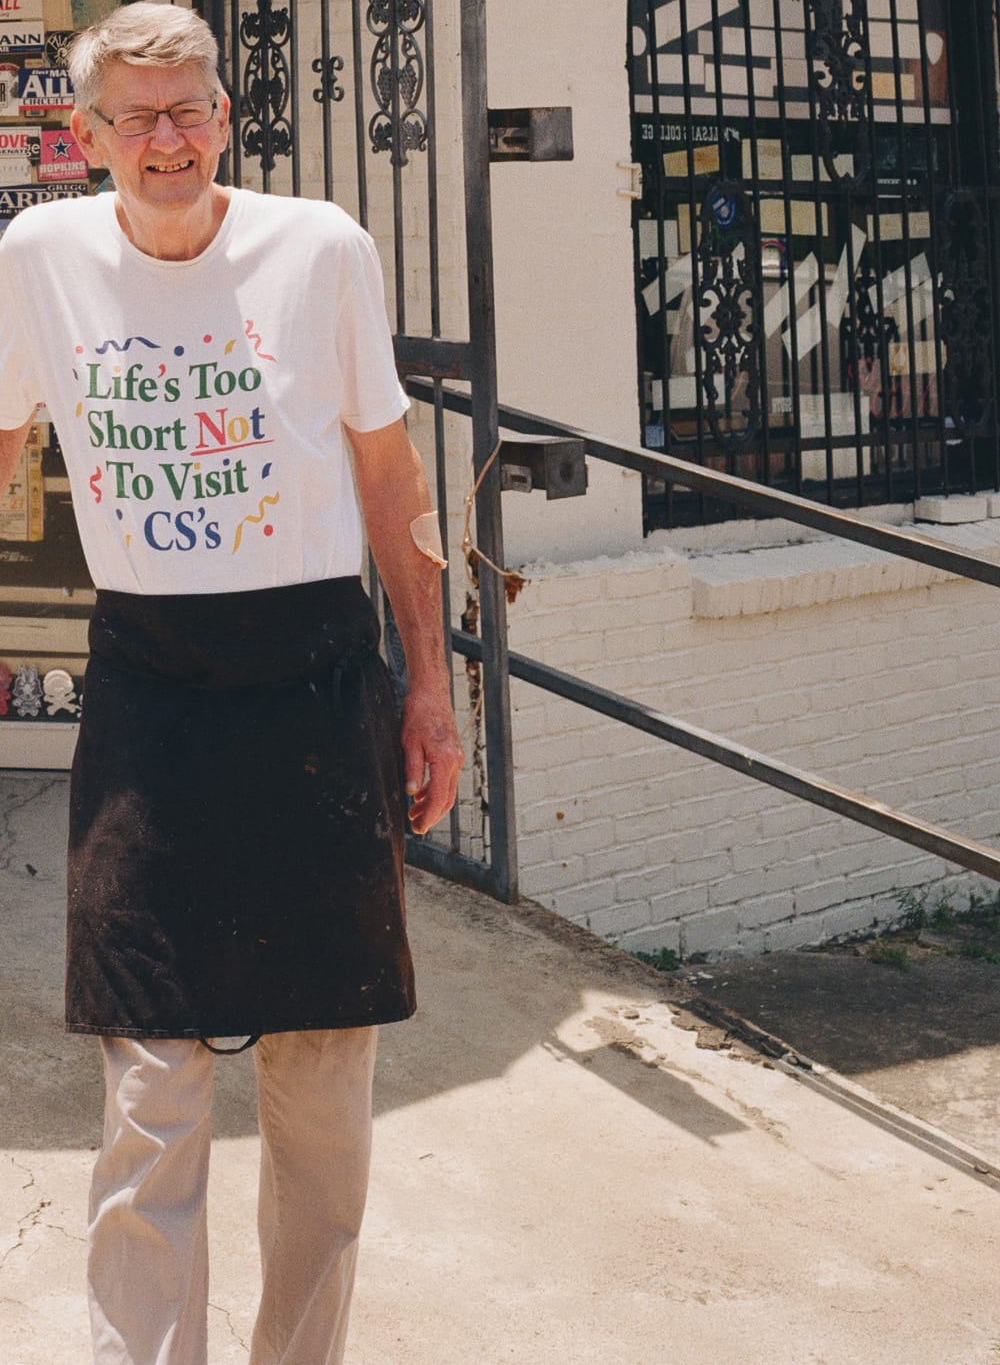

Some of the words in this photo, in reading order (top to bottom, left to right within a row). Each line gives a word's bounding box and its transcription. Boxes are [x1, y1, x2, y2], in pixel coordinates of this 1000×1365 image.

[39, 161, 86, 174] HOPKINS
[47, 184, 87, 192] GREGG
[85, 362, 181, 403] Life's
[188, 361, 262, 400] Too
[87, 409, 187, 451] Short
[194, 407, 266, 449] Not
[105, 460, 154, 501] To
[158, 458, 250, 501] Visit
[143, 506, 222, 551] CS's
